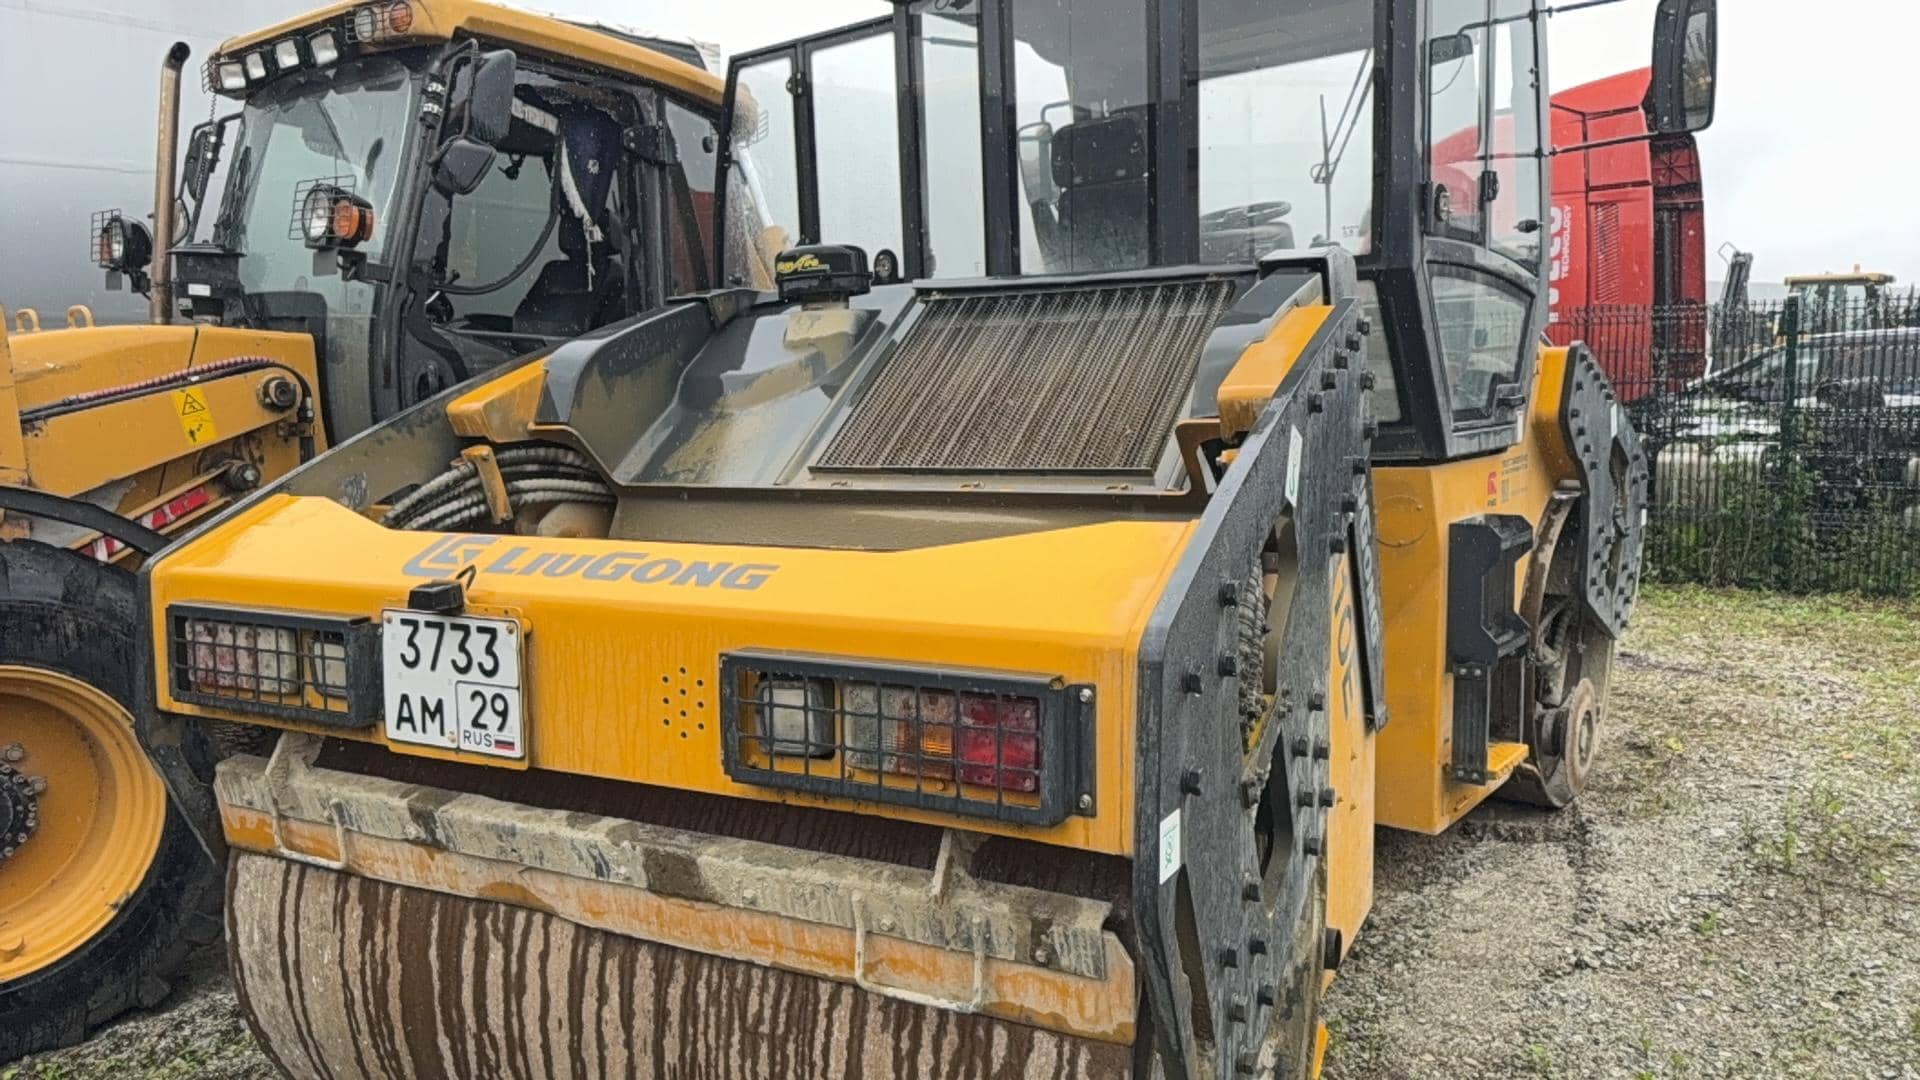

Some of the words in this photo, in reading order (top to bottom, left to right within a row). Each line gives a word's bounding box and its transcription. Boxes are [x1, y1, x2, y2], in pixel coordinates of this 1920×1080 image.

[1560, 205, 1572, 279] TECHNOLOGY
[400, 618, 500, 678] 3733
[396, 693, 445, 737] AM
[470, 690, 509, 732] 29
[463, 730, 493, 748] RUS
